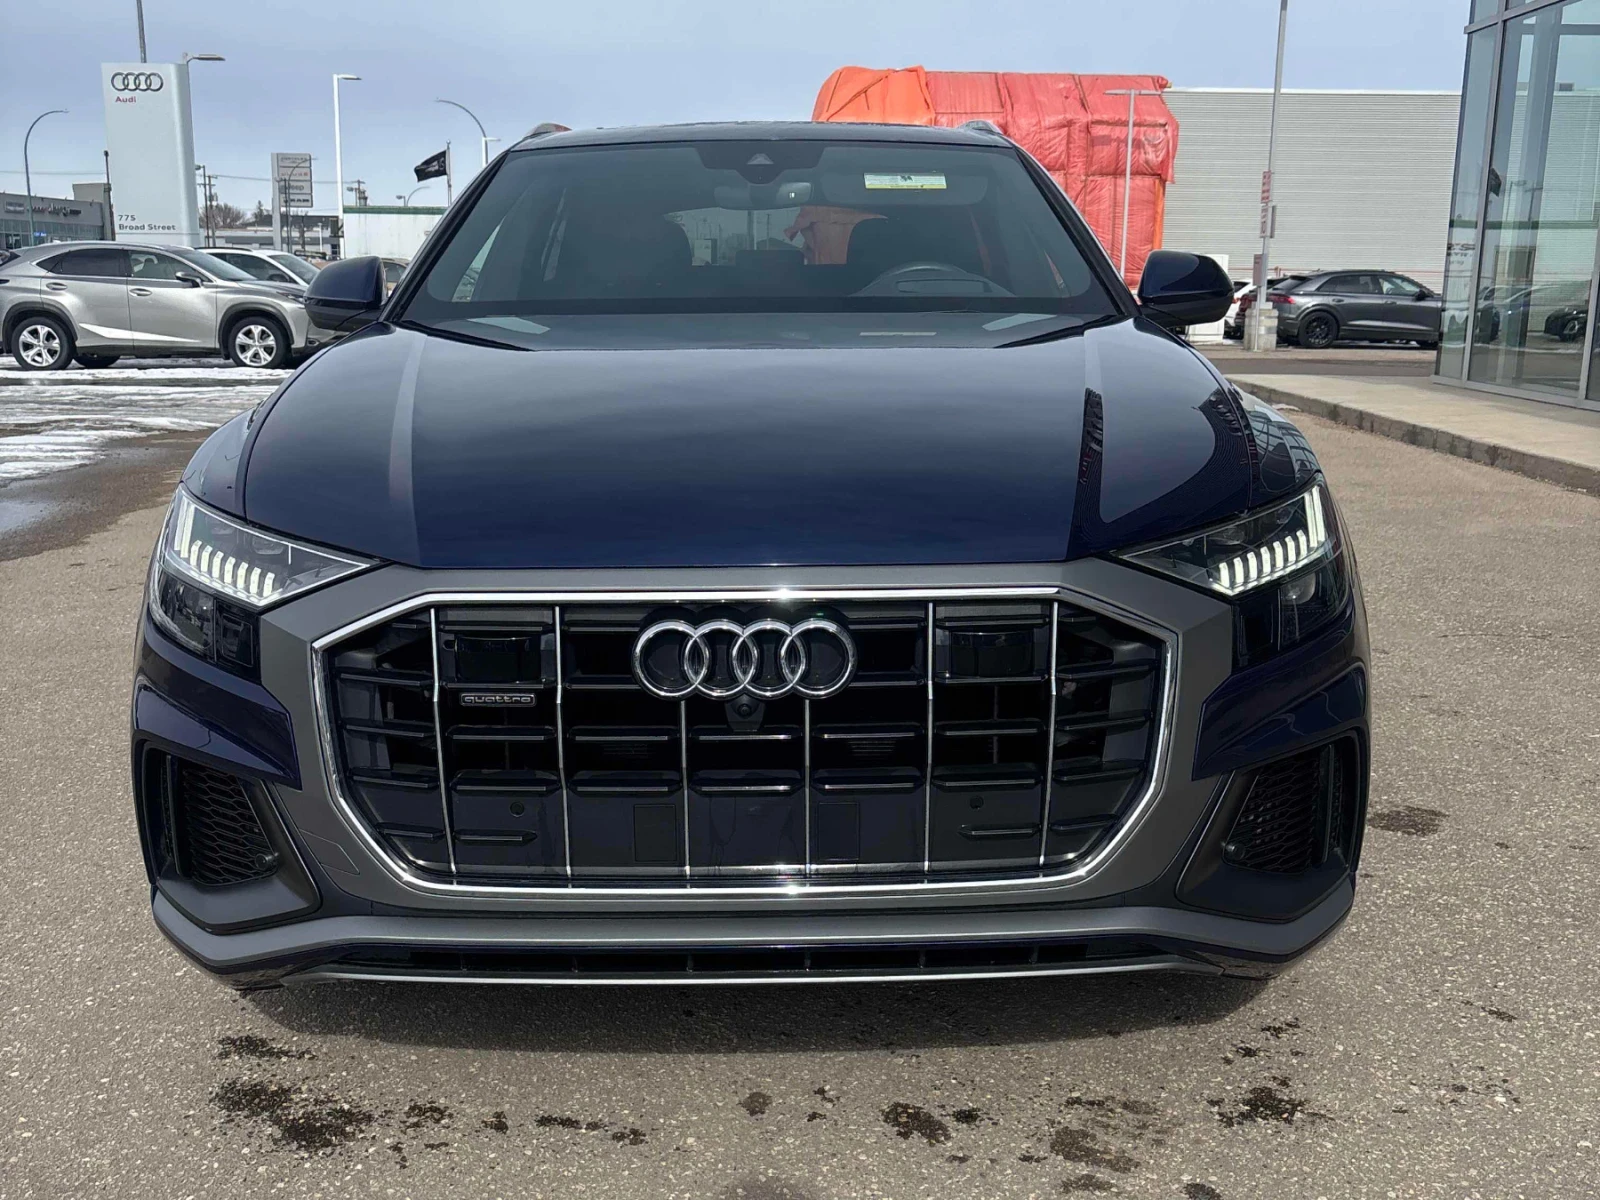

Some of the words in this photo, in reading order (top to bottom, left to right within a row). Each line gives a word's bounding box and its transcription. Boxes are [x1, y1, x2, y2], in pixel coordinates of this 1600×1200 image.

[118, 214, 136, 222] 775
[118, 223, 146, 231] Broad
[147, 223, 176, 231] Street
